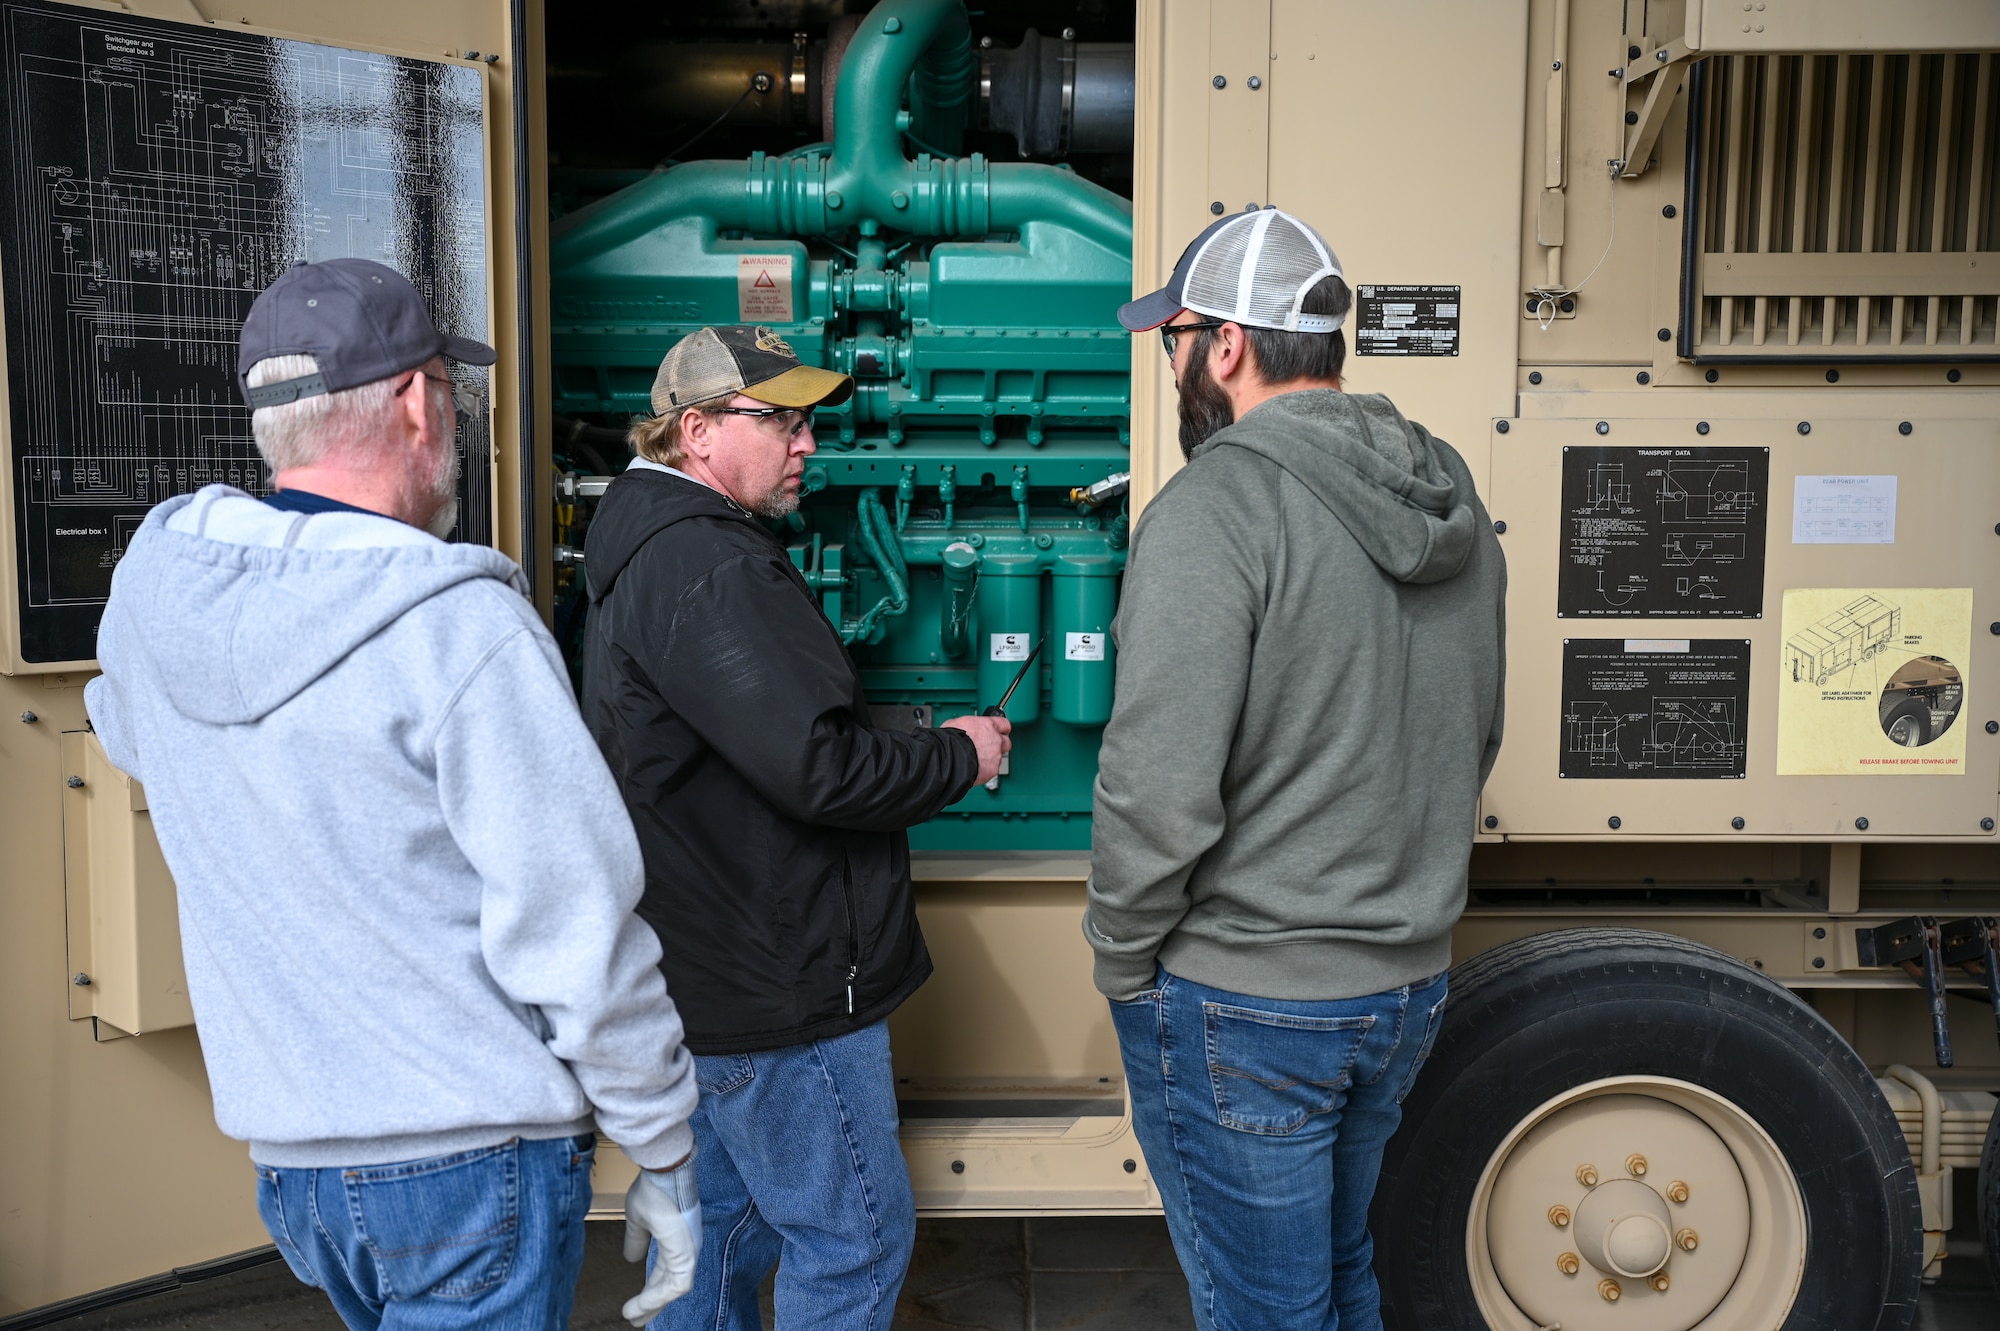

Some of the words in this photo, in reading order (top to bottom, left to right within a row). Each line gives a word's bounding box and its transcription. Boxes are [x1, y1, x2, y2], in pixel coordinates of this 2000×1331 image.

[104, 34, 140, 47] Switchgear
[106, 44, 135, 53] Electrical
[556, 295, 702, 319] Cummins
